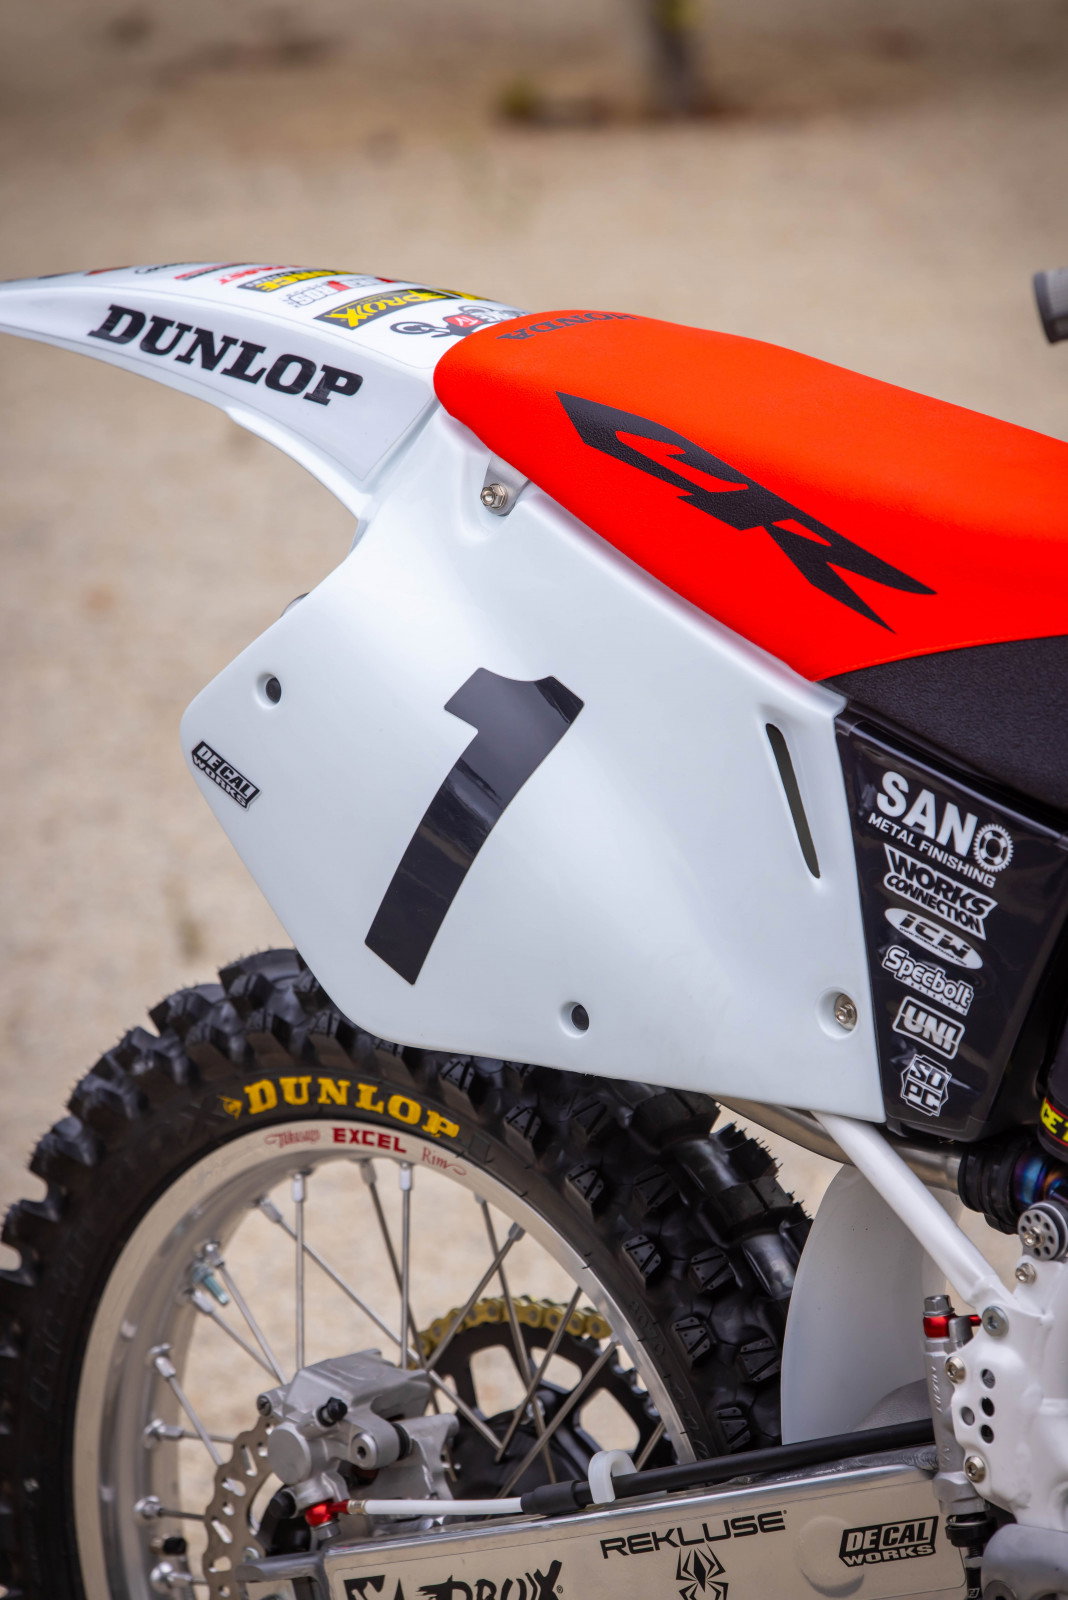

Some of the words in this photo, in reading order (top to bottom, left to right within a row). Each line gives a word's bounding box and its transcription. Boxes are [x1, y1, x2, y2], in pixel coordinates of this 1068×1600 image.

[324, 290, 447, 328] PROX
[496, 312, 640, 340] HONDA
[87, 304, 364, 406] DUNLOP
[555, 390, 938, 634] CR
[193, 755, 248, 807] WORKS
[195, 744, 258, 800] DECAL
[364, 667, 585, 985] 1
[868, 812, 916, 848] METAL
[919, 840, 997, 889] FINISHING
[877, 771, 1014, 873] SANO
[886, 875, 983, 936] CONNECTION
[888, 849, 992, 916] WORKS
[885, 948, 971, 1008] Specbolt
[903, 1004, 957, 1051] UNI
[244, 1075, 461, 1139] DUNLOP
[332, 1127, 407, 1153] EXCEL
[421, 1147, 460, 1174] Rim
[600, 1510, 787, 1560] REKLUSE
[842, 1544, 935, 1567] WORKS
[844, 1518, 935, 1552] DECAL
